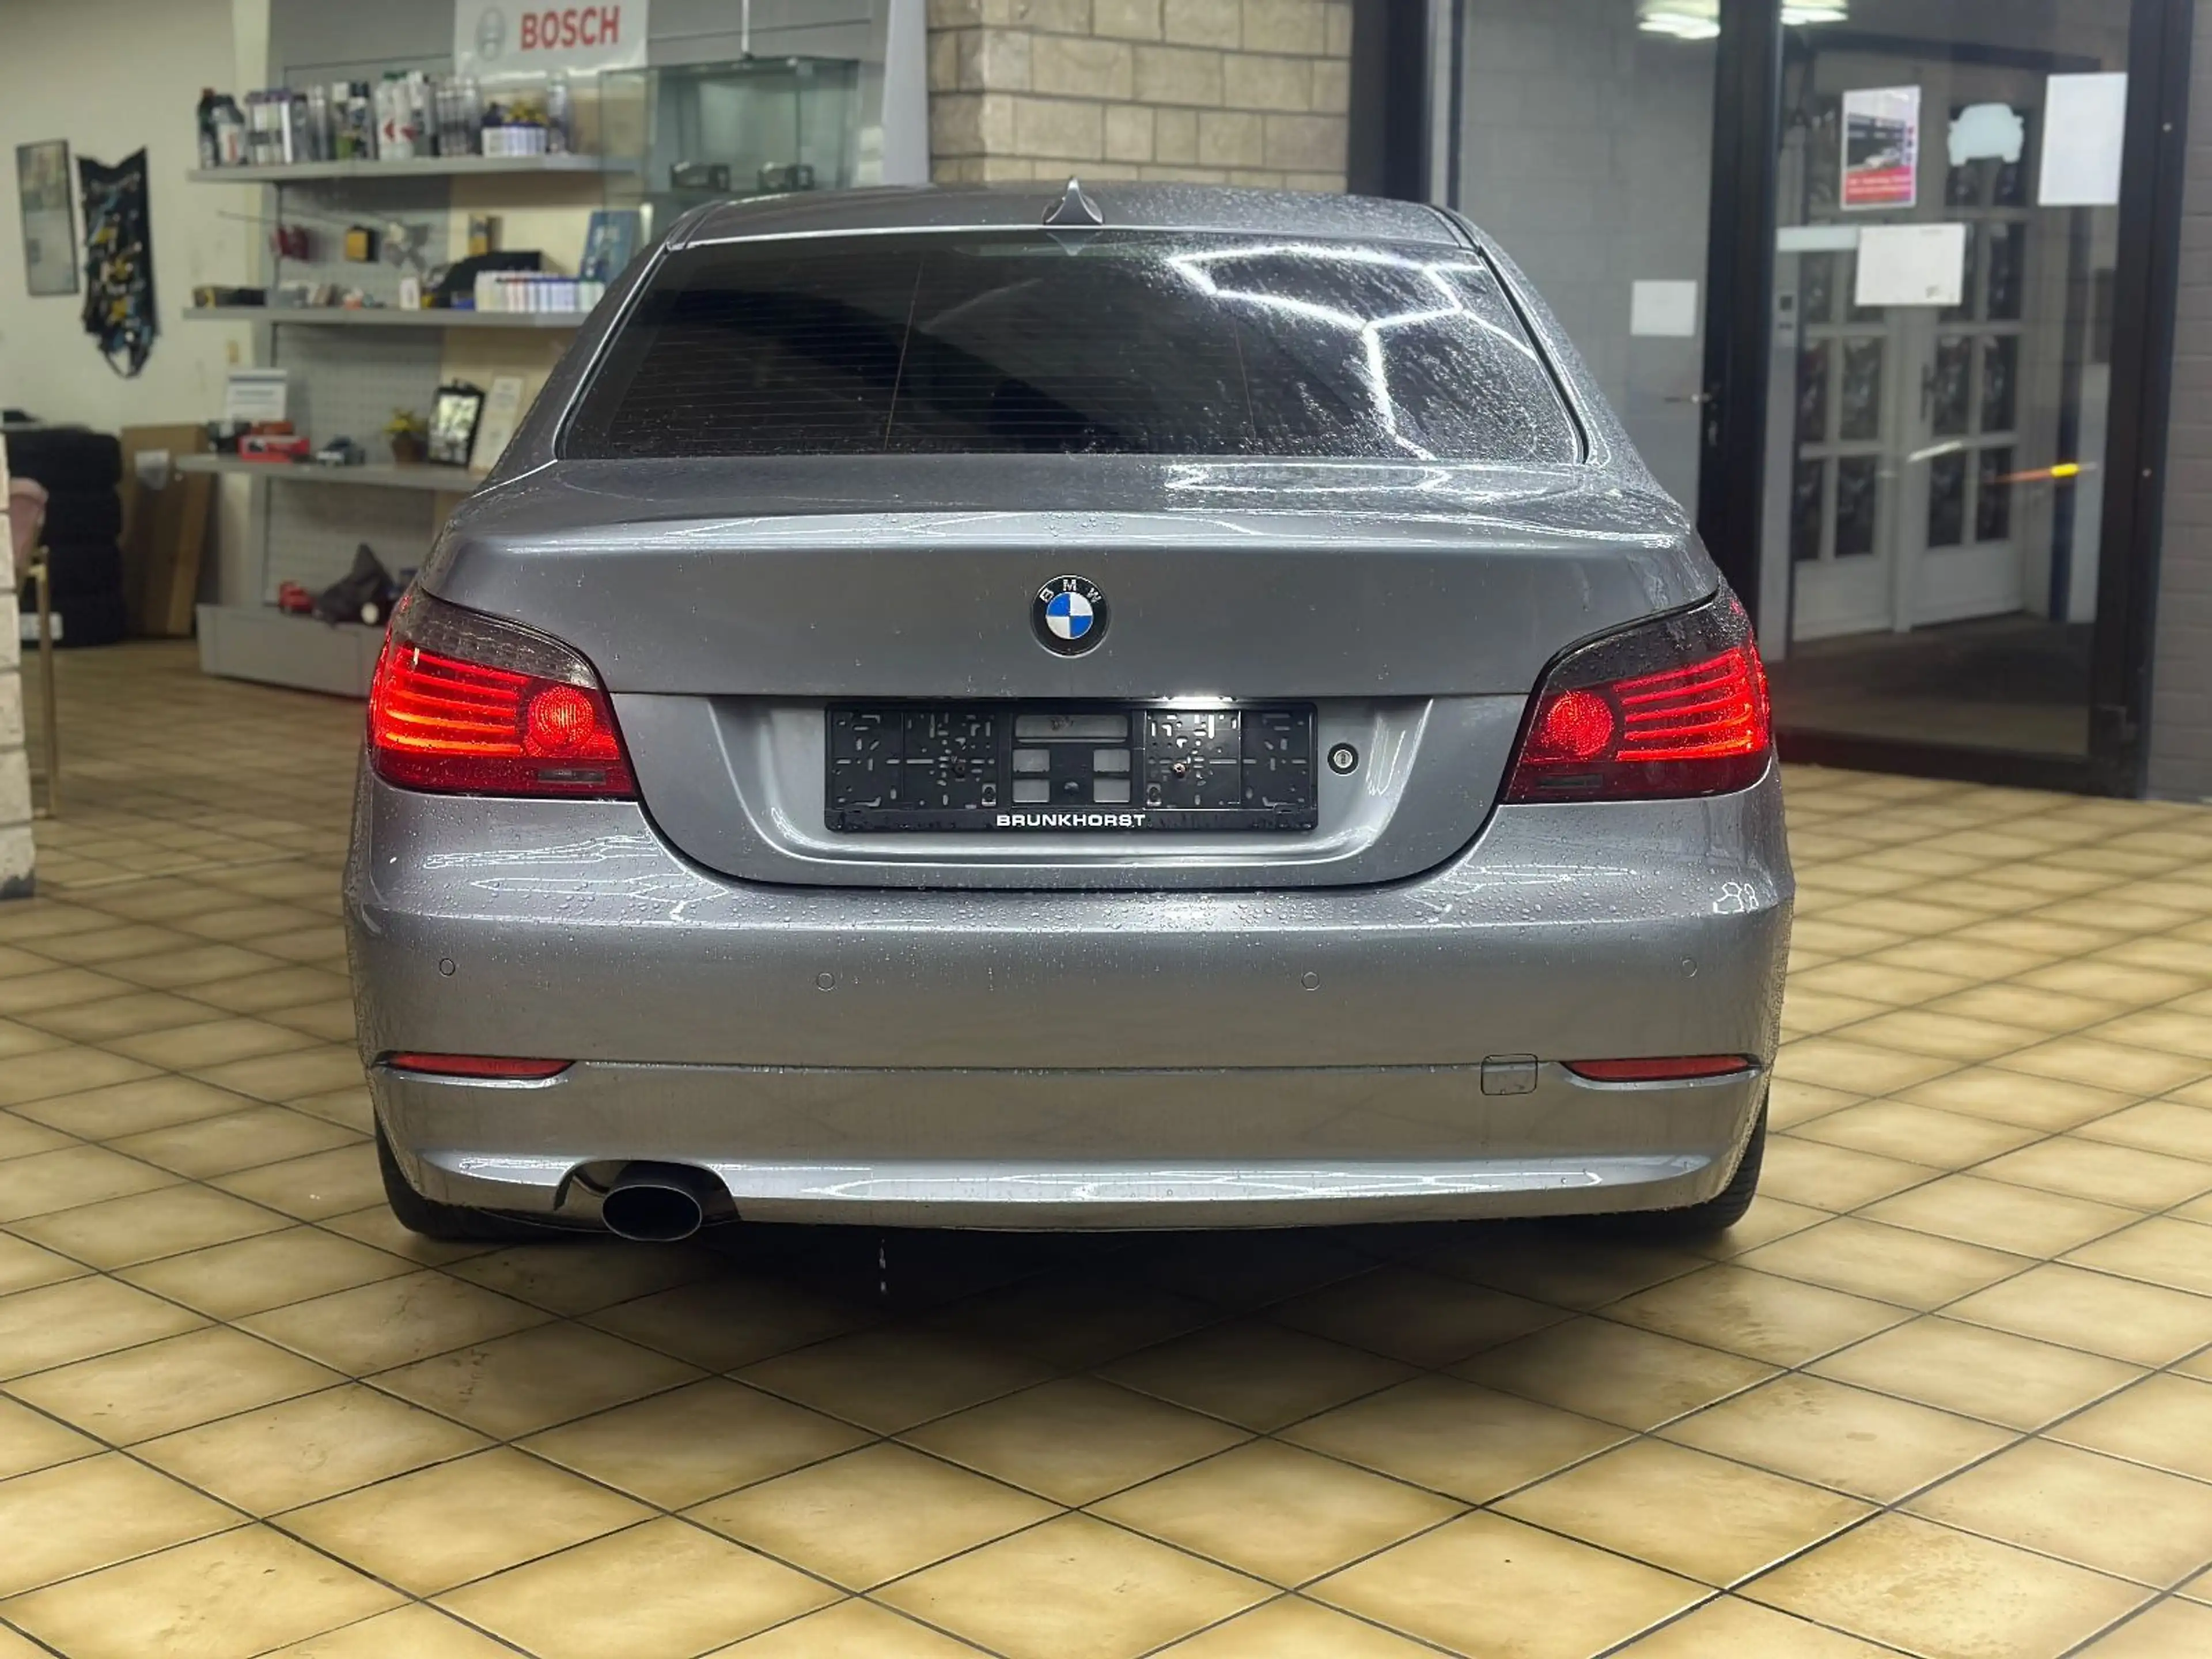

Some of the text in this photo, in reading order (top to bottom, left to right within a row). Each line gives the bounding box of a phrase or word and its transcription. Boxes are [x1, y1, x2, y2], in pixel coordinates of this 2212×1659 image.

[521, 6, 620, 51] BOSCH
[1039, 578, 1102, 603] BMW
[996, 814, 1146, 827] BRUNKHORST
